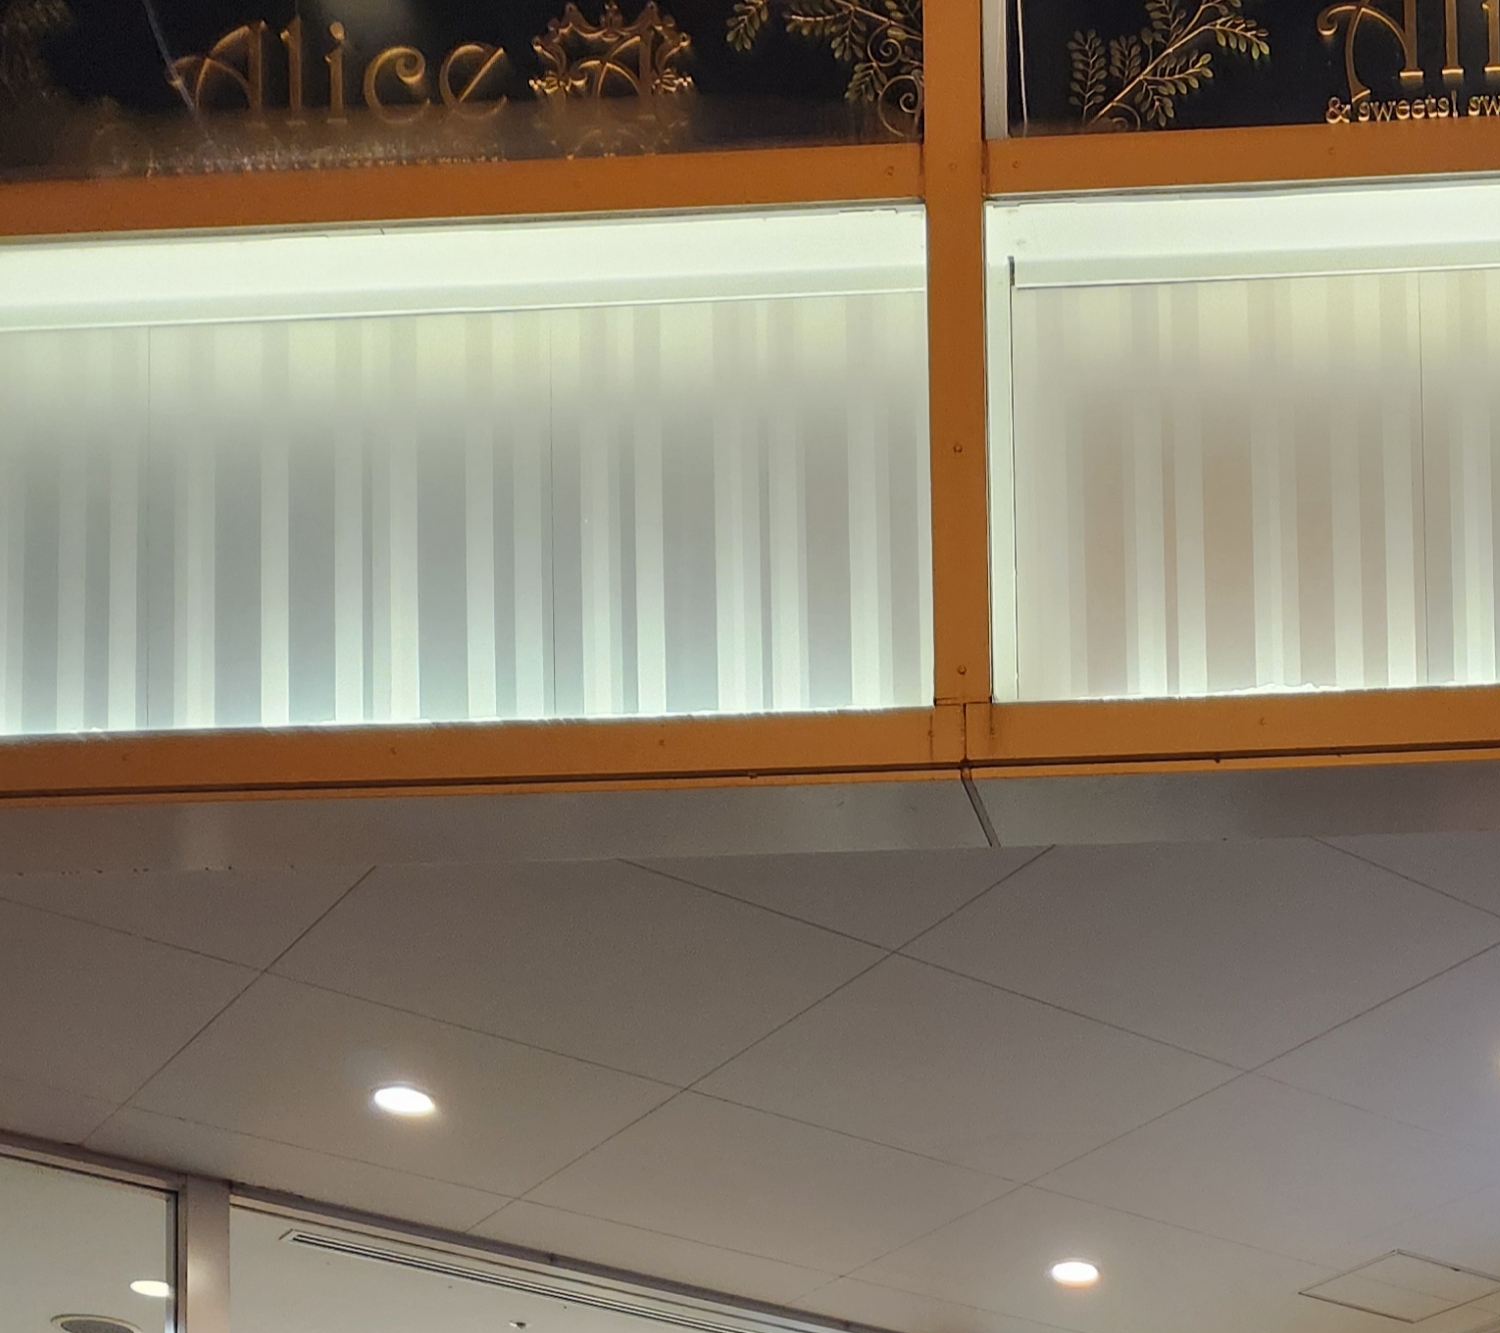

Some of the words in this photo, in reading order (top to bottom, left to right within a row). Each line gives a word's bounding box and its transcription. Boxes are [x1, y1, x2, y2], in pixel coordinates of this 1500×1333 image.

[167, 15, 506, 127] Alice
[1325, 96, 1350, 124] &
[1357, 90, 1459, 121] sweets!
